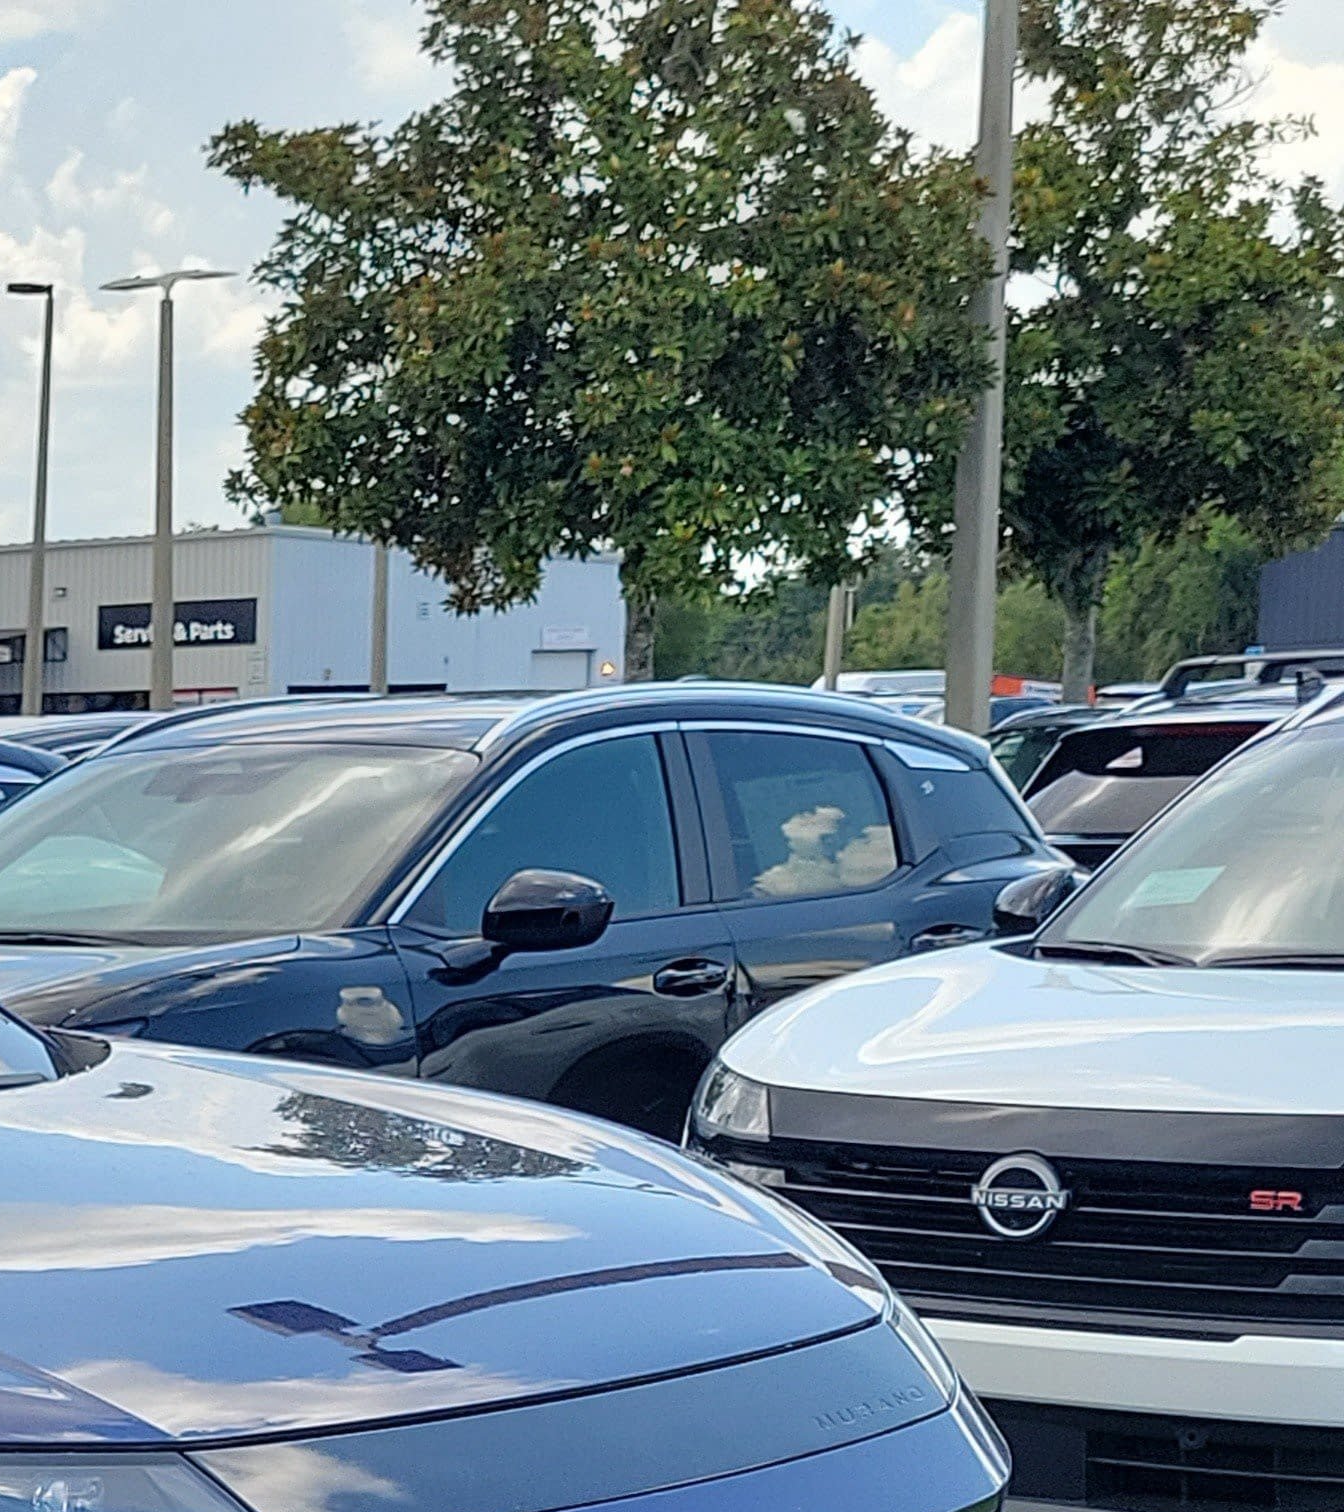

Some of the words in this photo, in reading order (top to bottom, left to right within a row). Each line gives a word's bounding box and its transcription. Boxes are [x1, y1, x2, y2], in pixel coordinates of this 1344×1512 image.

[173, 621, 188, 642] &
[189, 620, 235, 641] Parts
[971, 1189, 1064, 1212] NISSAN
[1249, 1189, 1304, 1211] SR
